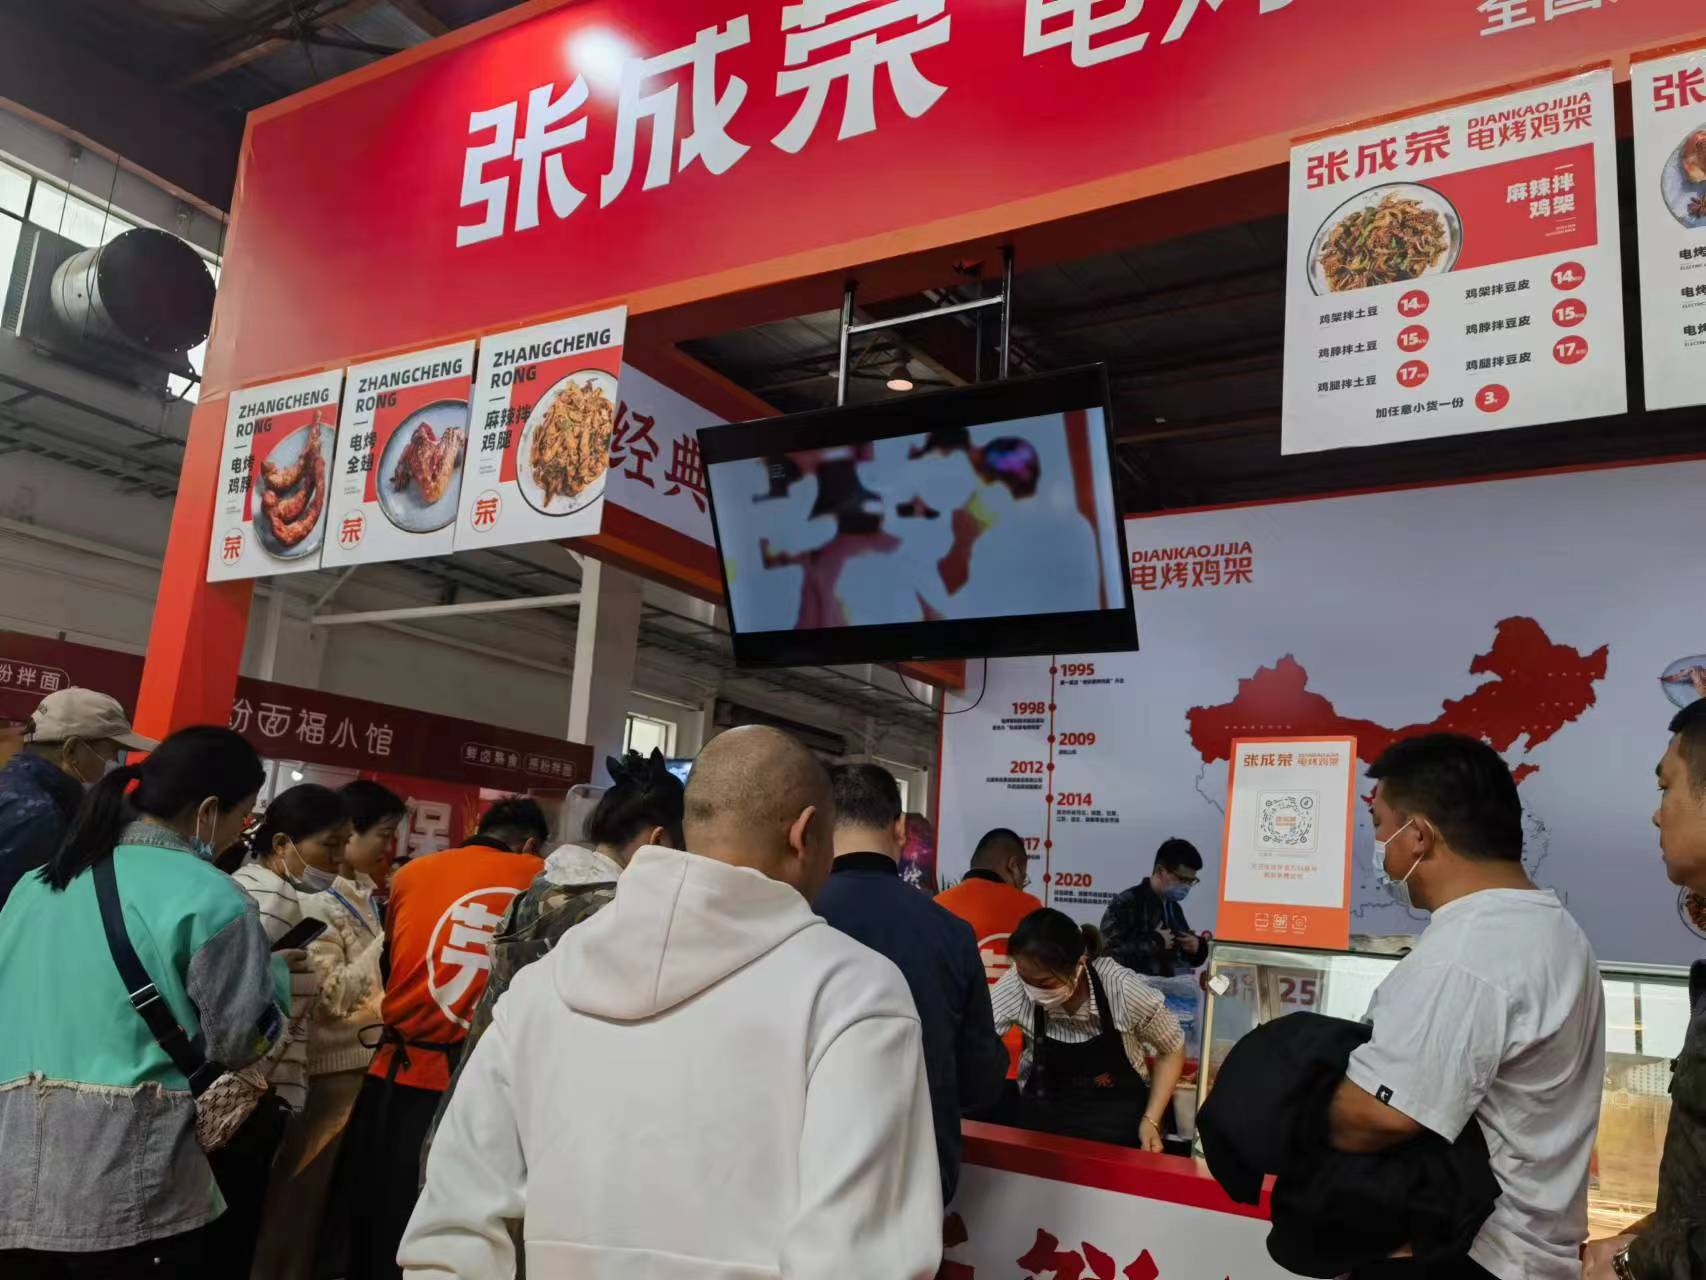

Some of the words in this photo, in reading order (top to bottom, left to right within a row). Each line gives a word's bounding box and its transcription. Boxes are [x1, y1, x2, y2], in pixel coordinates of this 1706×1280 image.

[1467, 92, 1592, 130] DIANKAOJIJIA
[456, 0, 951, 248] 张成荣
[1467, 104, 1593, 151] 电烤鸡架
[1306, 125, 1451, 189] 张成荣
[1506, 172, 1576, 203] 麻辣拌
[1529, 194, 1576, 219] 鸡架
[1465, 279, 1531, 300] 鸡架拌豆皮
[1319, 306, 1379, 325] 鸡架拌土豆
[493, 328, 611, 368] ZHANGCHENG
[1465, 352, 1532, 372] 鸡腿拌豆皮
[358, 358, 463, 393] ZHANGCHENG
[490, 365, 537, 388] RONG
[1317, 375, 1377, 393] 鸡腿拌土豆
[238, 388, 330, 419] ZHANGCHENG
[355, 392, 398, 414] RONG
[236, 417, 273, 438] RONG
[484, 405, 532, 431] 麻辣拌
[349, 431, 377, 452] 电烤
[481, 430, 513, 452] 鸡腿
[231, 455, 255, 474] 电烤
[609, 399, 708, 514] 经典
[475, 497, 498, 525] 荣
[341, 517, 362, 543] 荣
[223, 535, 242, 560] 荣
[1132, 541, 1253, 563] DIANKAOJIJIA
[1131, 557, 1253, 590] 电烤鸡架
[1060, 663, 1095, 676] 1995
[1012, 702, 1046, 715] 1998
[1059, 732, 1096, 746] 2009
[1010, 761, 1044, 774] 2012
[1243, 753, 1293, 767] 张成荣
[1057, 793, 1092, 806] 2014
[1020, 837, 1041, 851] 17
[1055, 872, 1092, 887] 2020
[1279, 977, 1317, 1006] 25
